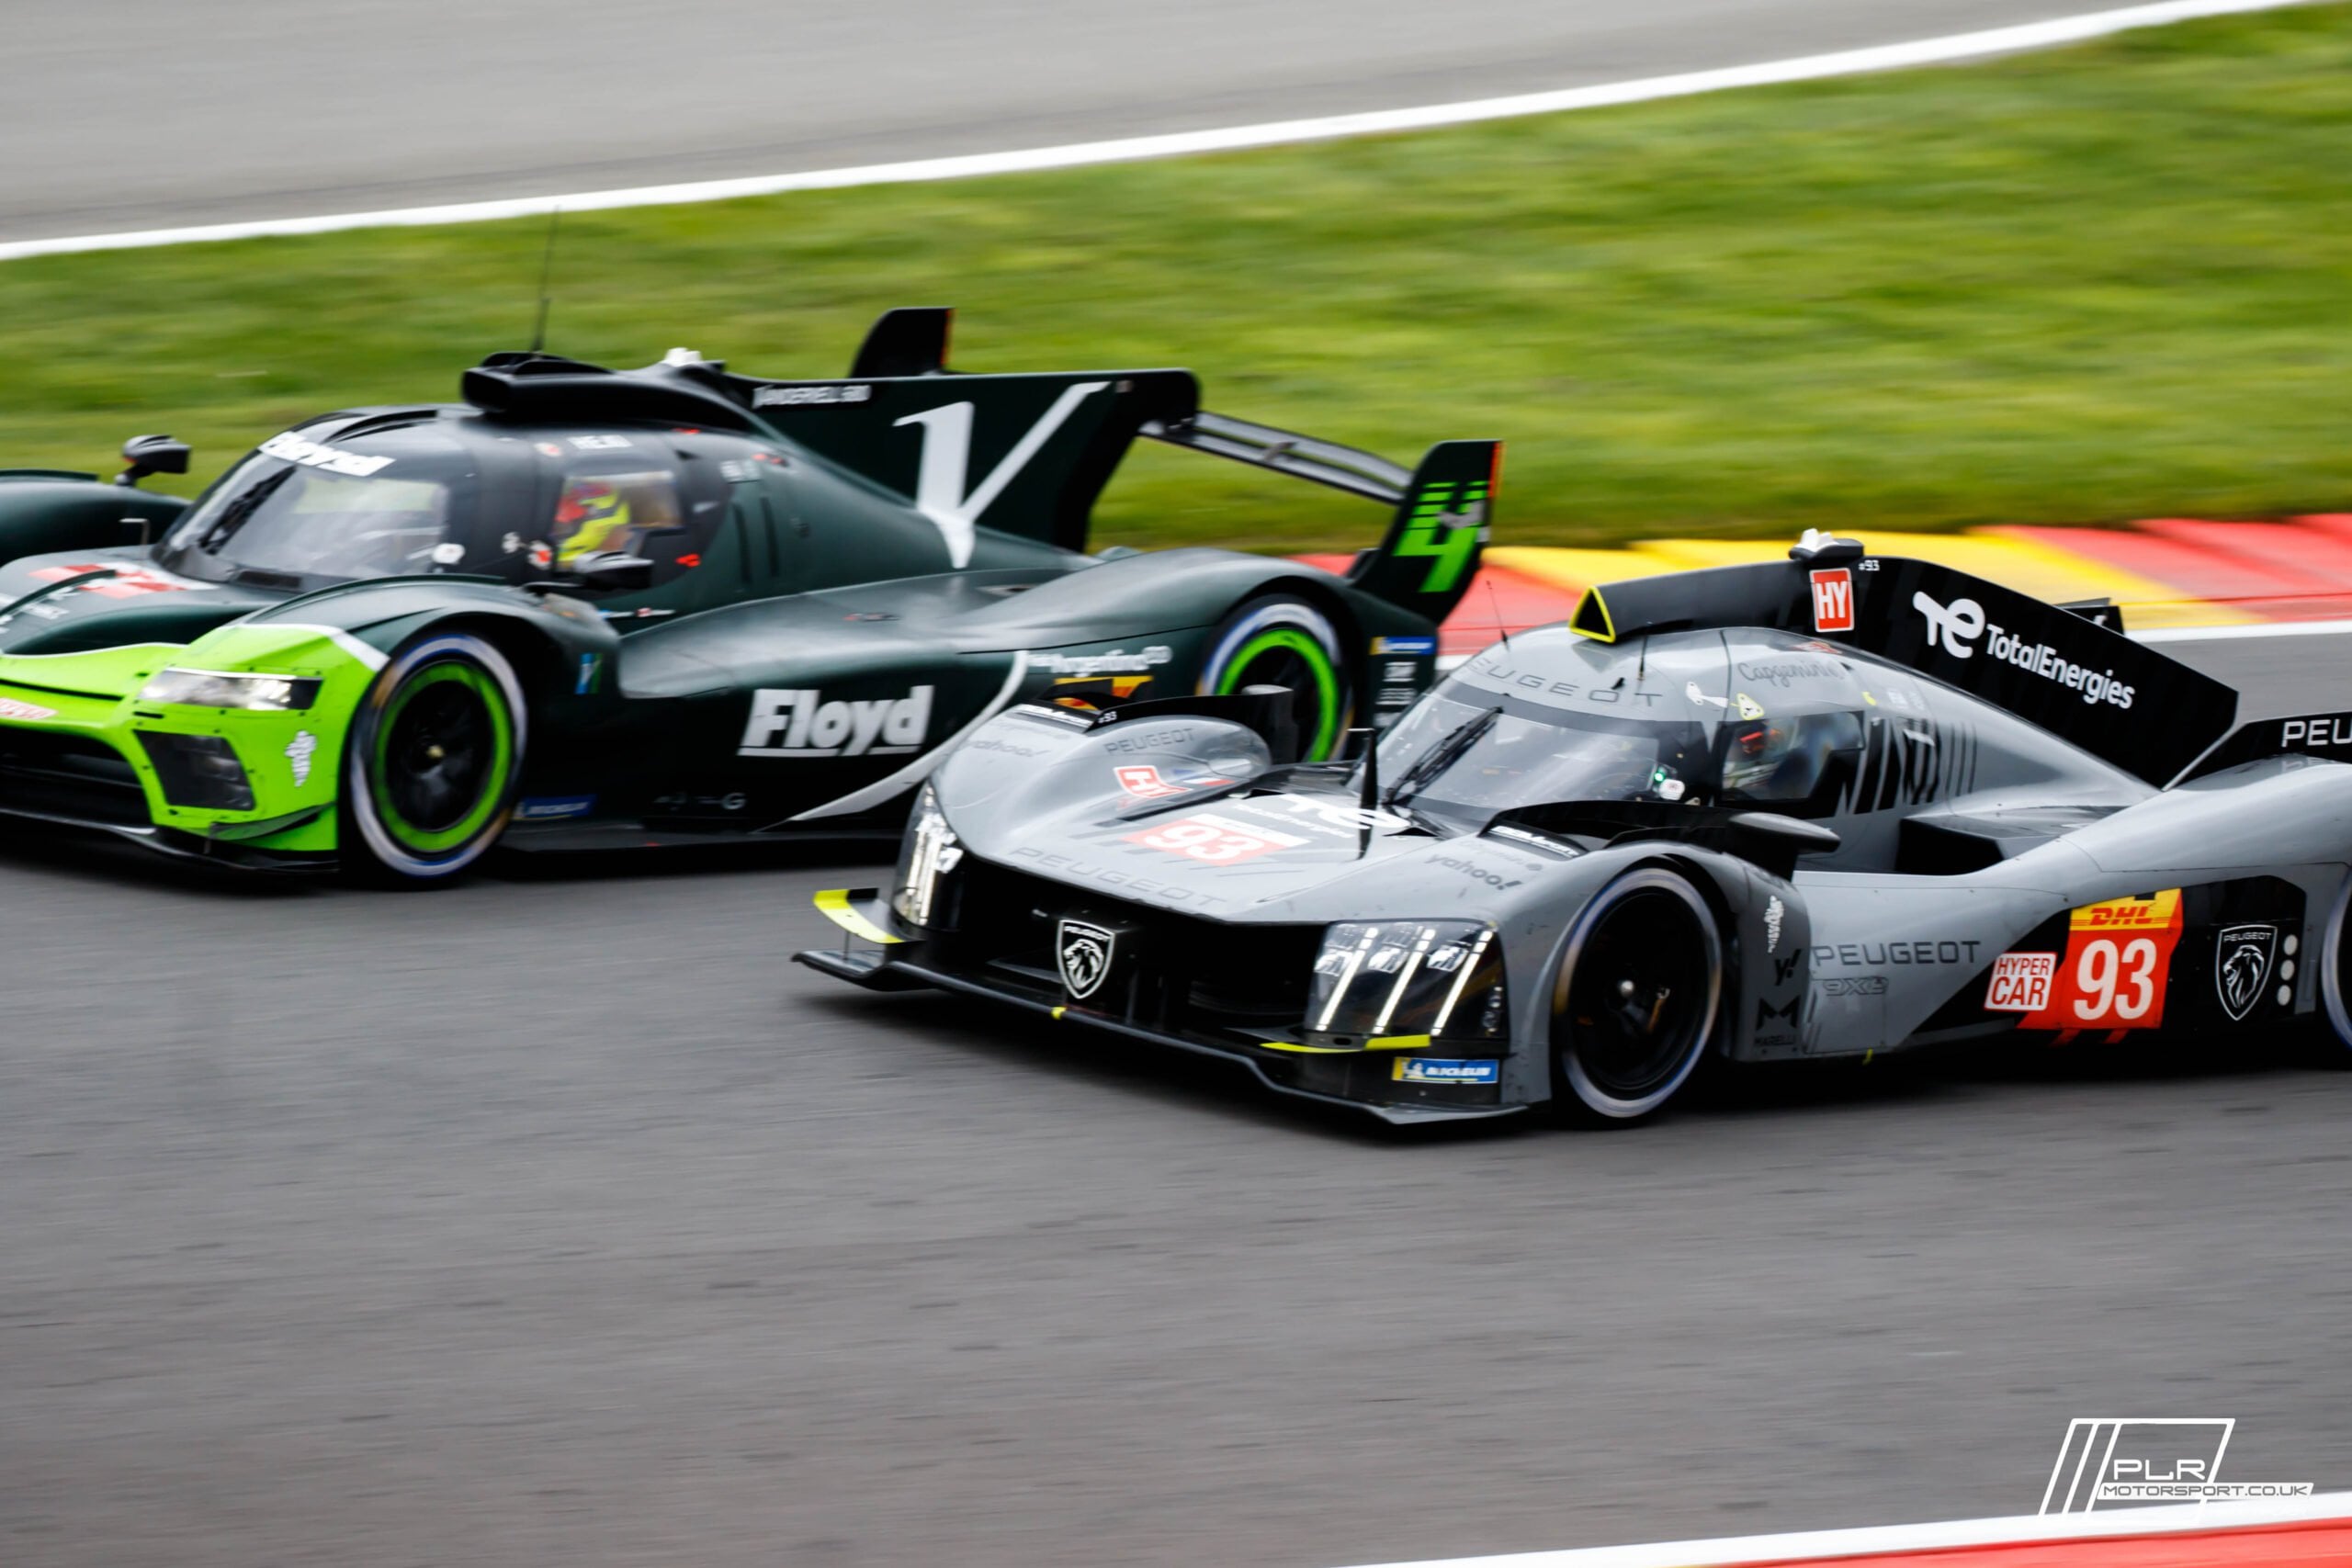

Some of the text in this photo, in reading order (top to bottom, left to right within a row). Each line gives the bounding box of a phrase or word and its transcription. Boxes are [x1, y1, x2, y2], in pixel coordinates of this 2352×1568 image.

[1392, 480, 1489, 593] 4
[1815, 581, 1849, 620] HY
[1467, 657, 1663, 707] EUGEOT
[1986, 624, 2136, 709] TotalEnergies
[739, 684, 935, 758] Floyd
[2281, 718, 2352, 748] PEU
[1104, 728, 1195, 754] PEUGEOT
[1144, 825, 1265, 861] 93
[1009, 846, 1227, 907] PEUGEOT
[1423, 854, 1523, 891] yahoo!
[2089, 906, 2154, 926] DHL
[1810, 941, 1982, 967] PEUGEOT
[2223, 931, 2273, 943] PEUGEOT
[1996, 956, 2051, 976] HYPER
[2073, 938, 2157, 1021] 93
[1990, 976, 2047, 1007] CAR
